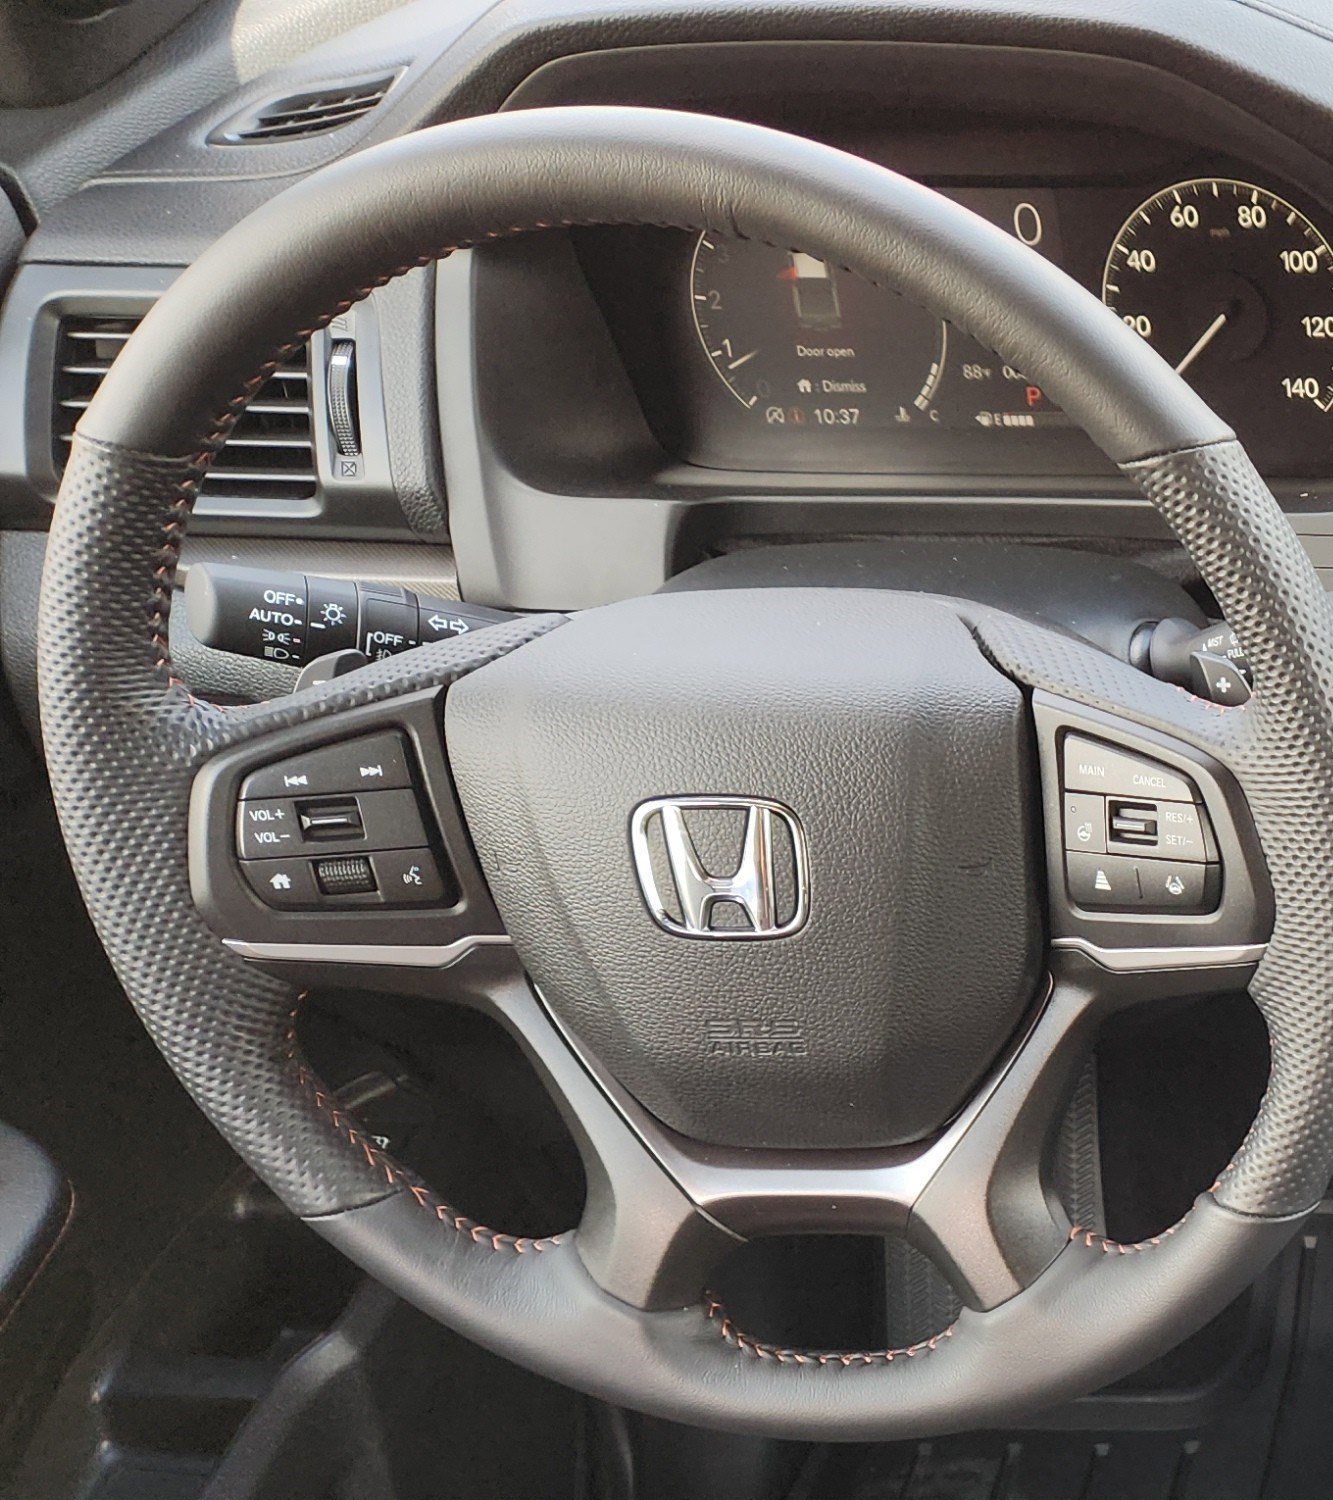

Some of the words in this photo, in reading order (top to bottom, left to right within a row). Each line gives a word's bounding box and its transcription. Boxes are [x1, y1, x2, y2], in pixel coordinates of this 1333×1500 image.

[1170, 205, 1199, 228] 60
[1237, 205, 1266, 229] 80
[1126, 250, 1156, 273] 40
[1279, 250, 1319, 274] 100
[708, 290, 722, 310] 2
[722, 338, 733, 358] 1
[796, 345, 826, 358] Door
[826, 347, 855, 360] open
[822, 380, 868, 393] Dismiss
[1025, 386, 1041, 407] P
[1281, 377, 1320, 400] 140
[813, 408, 860, 425] 10:37
[263, 590, 296, 606] OFF
[249, 608, 295, 628] AUTO
[373, 631, 404, 648] OFF
[1079, 763, 1105, 778] MAIN
[1132, 774, 1167, 789] CANCEL
